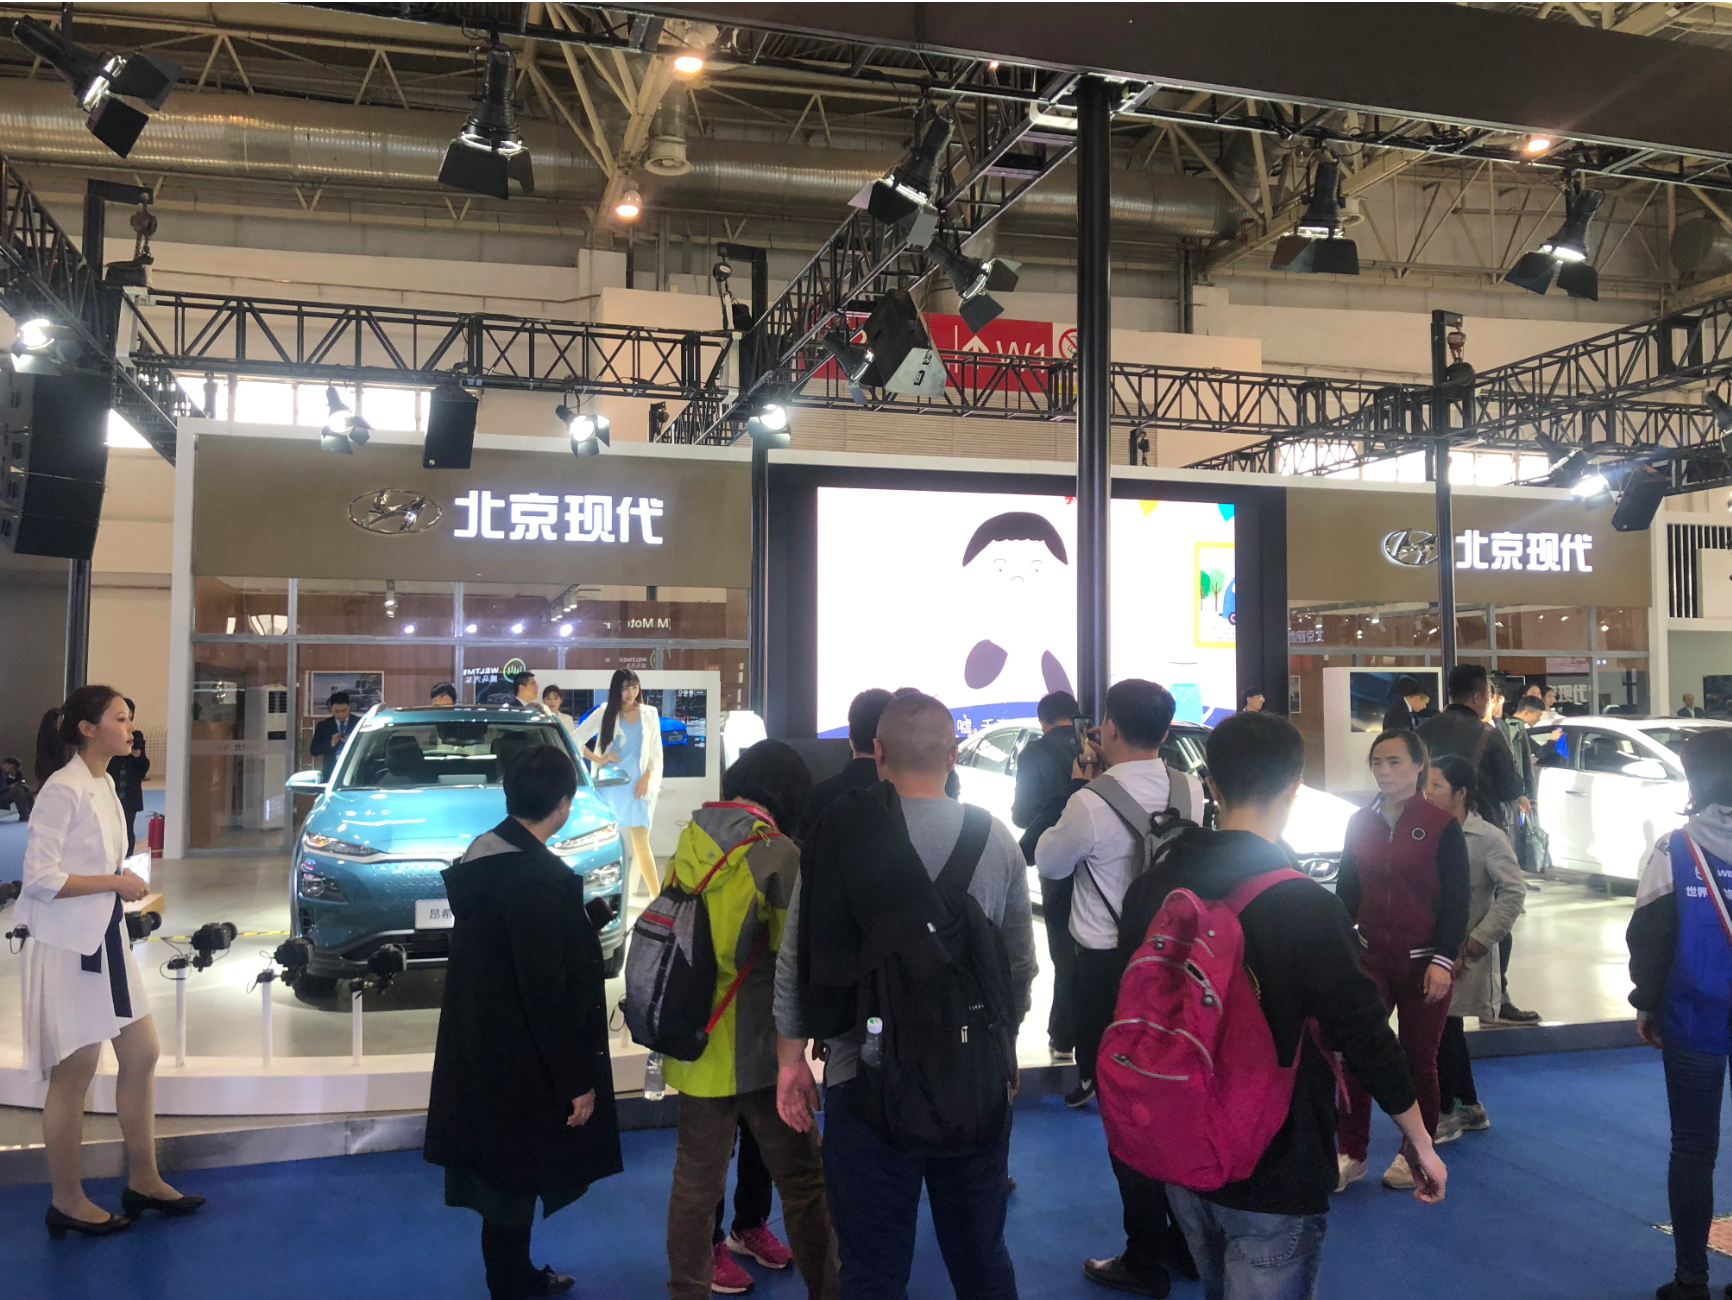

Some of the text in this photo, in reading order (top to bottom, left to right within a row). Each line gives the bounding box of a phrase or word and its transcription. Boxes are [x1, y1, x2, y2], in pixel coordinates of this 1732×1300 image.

[997, 341, 1045, 373] W1
[454, 490, 663, 544] 北京现代
[1455, 529, 1593, 572] 北京现代
